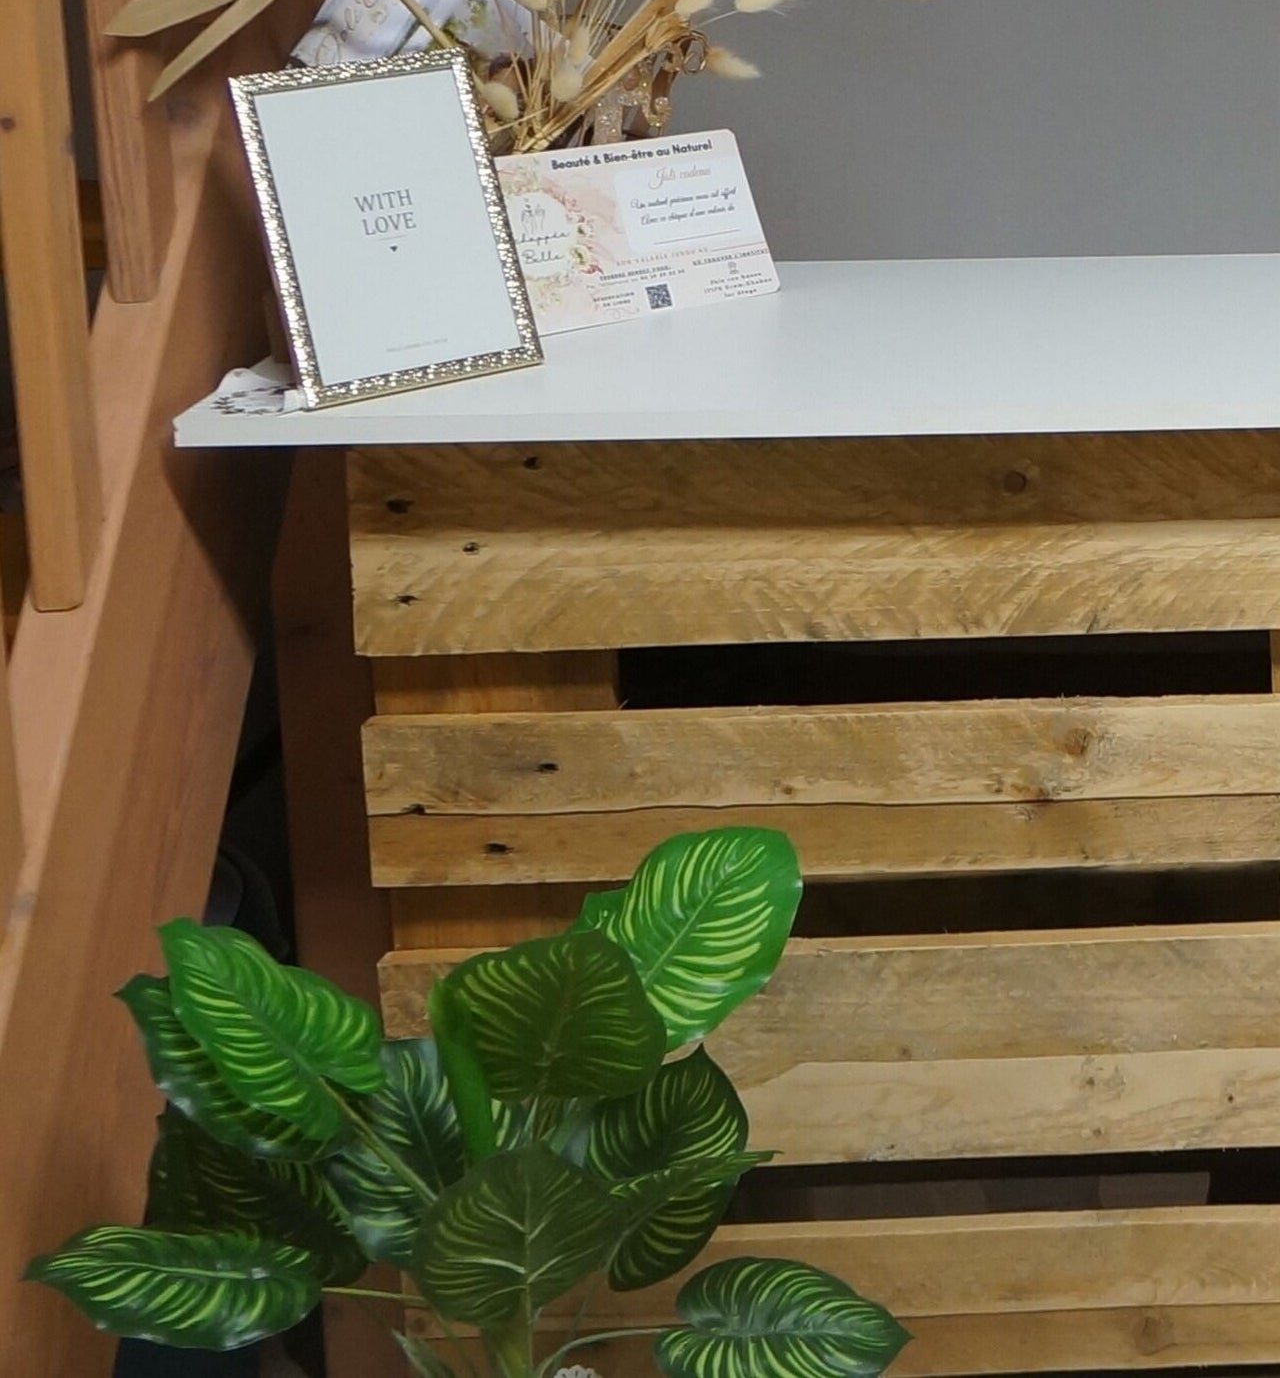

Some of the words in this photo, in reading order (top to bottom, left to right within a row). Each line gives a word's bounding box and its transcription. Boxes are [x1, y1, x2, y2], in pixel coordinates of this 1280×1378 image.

[551, 155, 591, 170] Beauté
[593, 154, 602, 165] &
[603, 149, 654, 164] Bien-être
[656, 148, 670, 157] au
[672, 139, 713, 154] Naturel
[354, 189, 413, 213] WITH
[362, 211, 417, 236] LOVE
[521, 248, 566, 265] Belle
